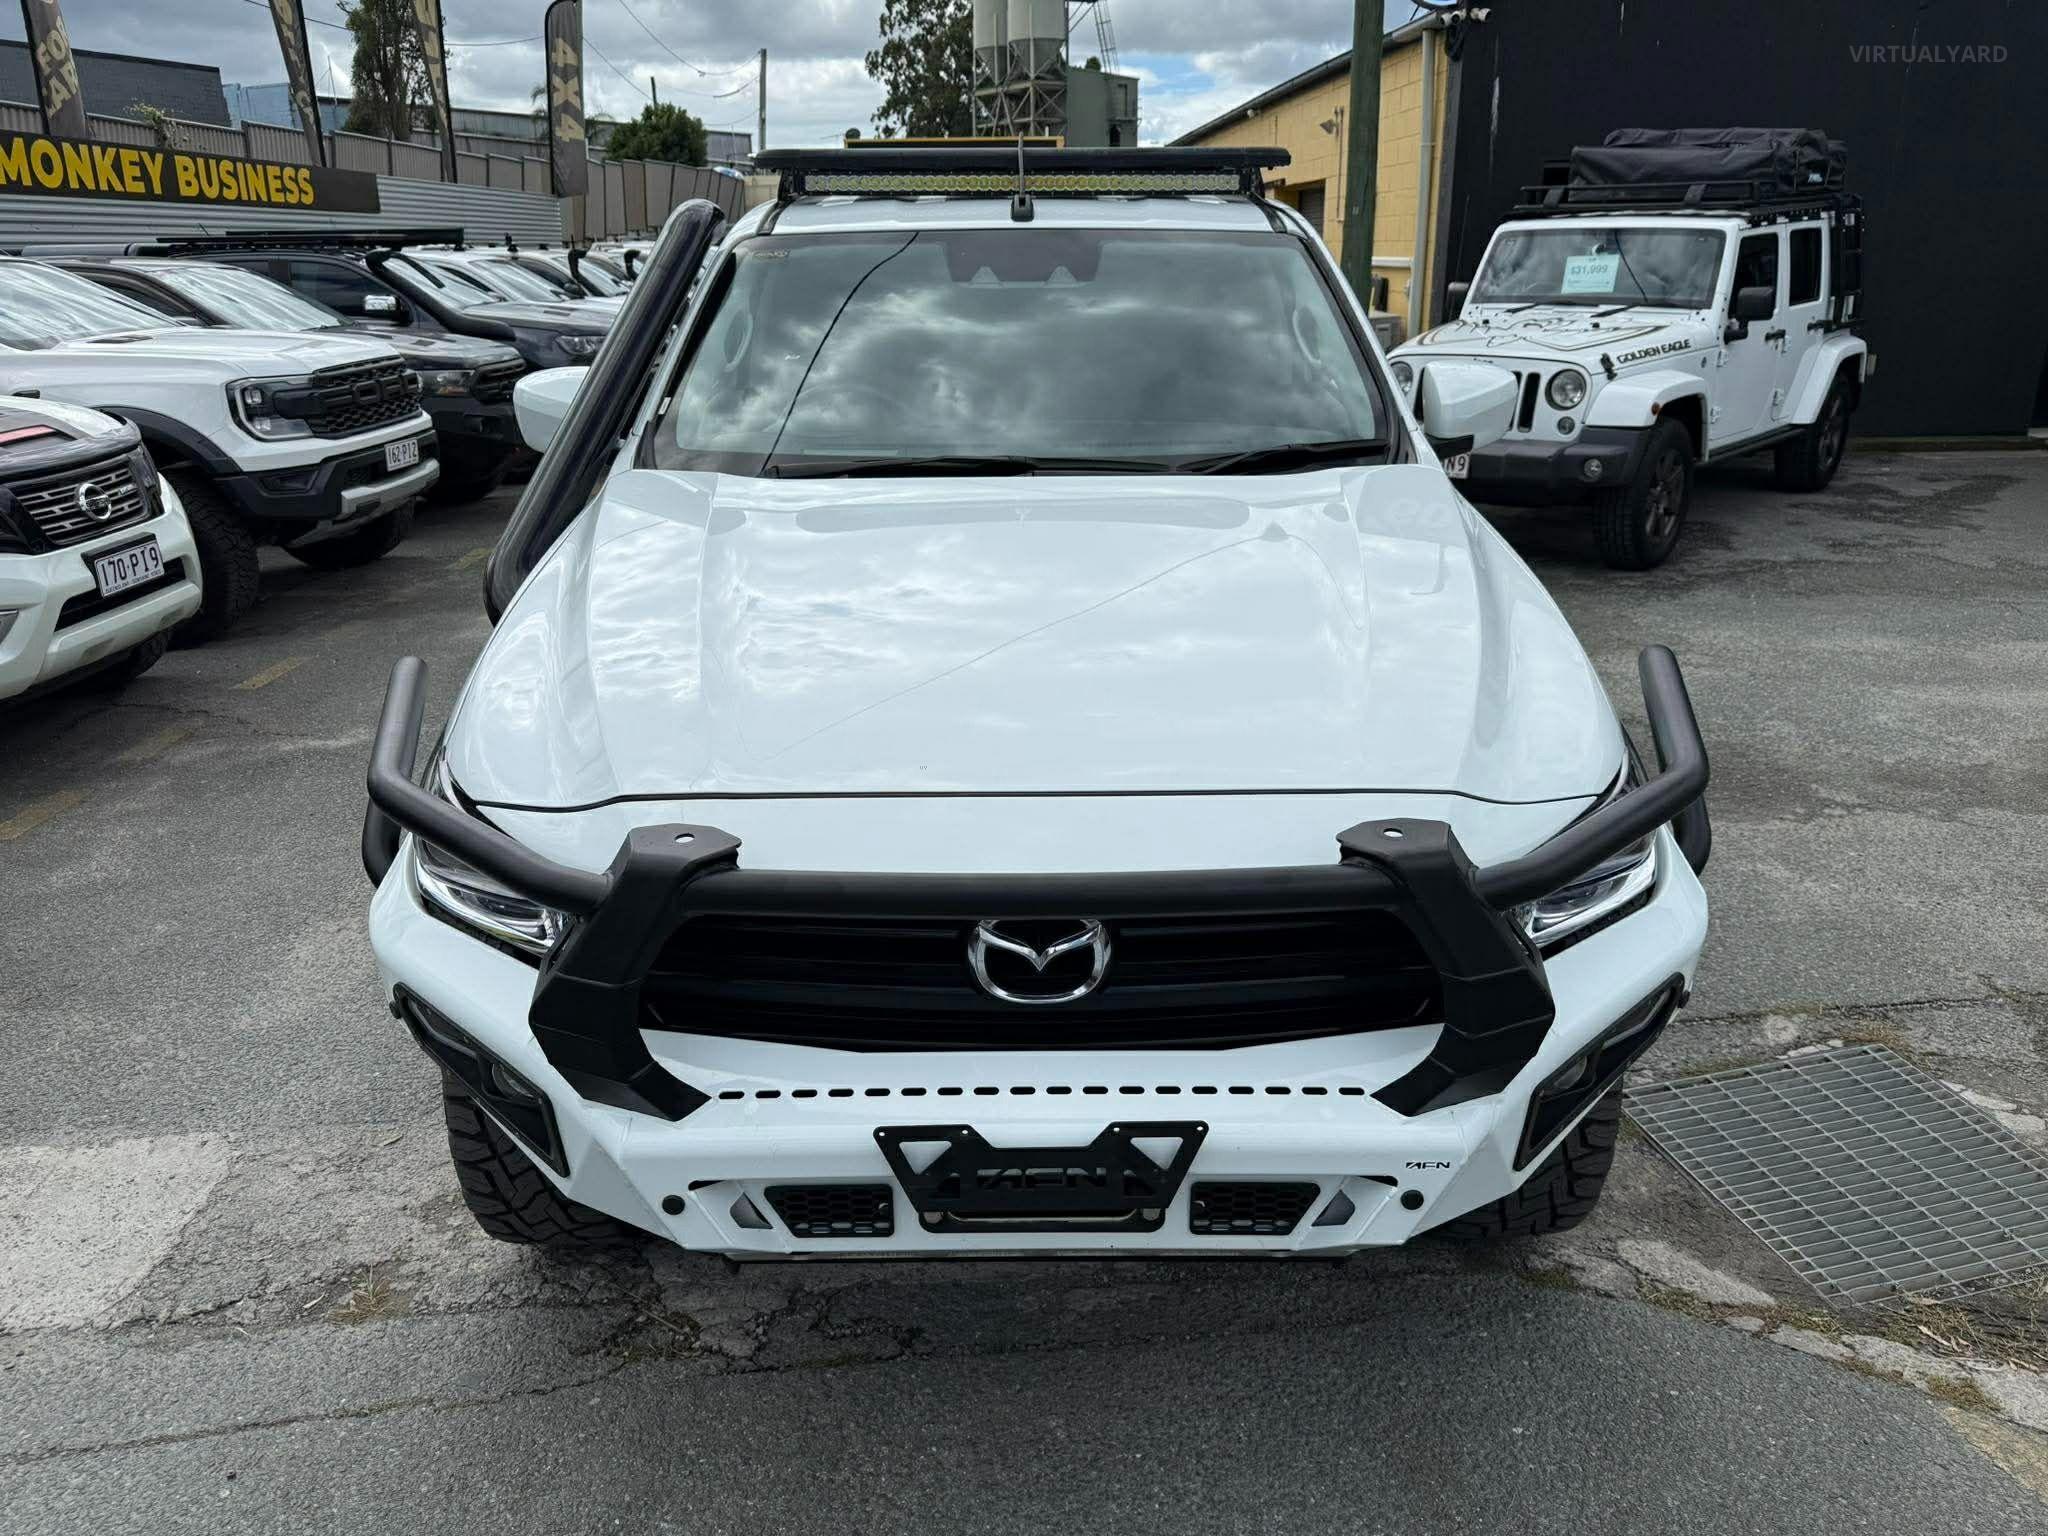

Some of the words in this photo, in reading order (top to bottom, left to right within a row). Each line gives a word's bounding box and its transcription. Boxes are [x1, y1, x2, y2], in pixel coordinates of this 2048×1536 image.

[0, 136, 164, 194] MONKEY
[174, 154, 315, 205] BUSINESS
[1617, 346, 1661, 364] GOLDEN
[1661, 339, 1691, 354] EAGLE
